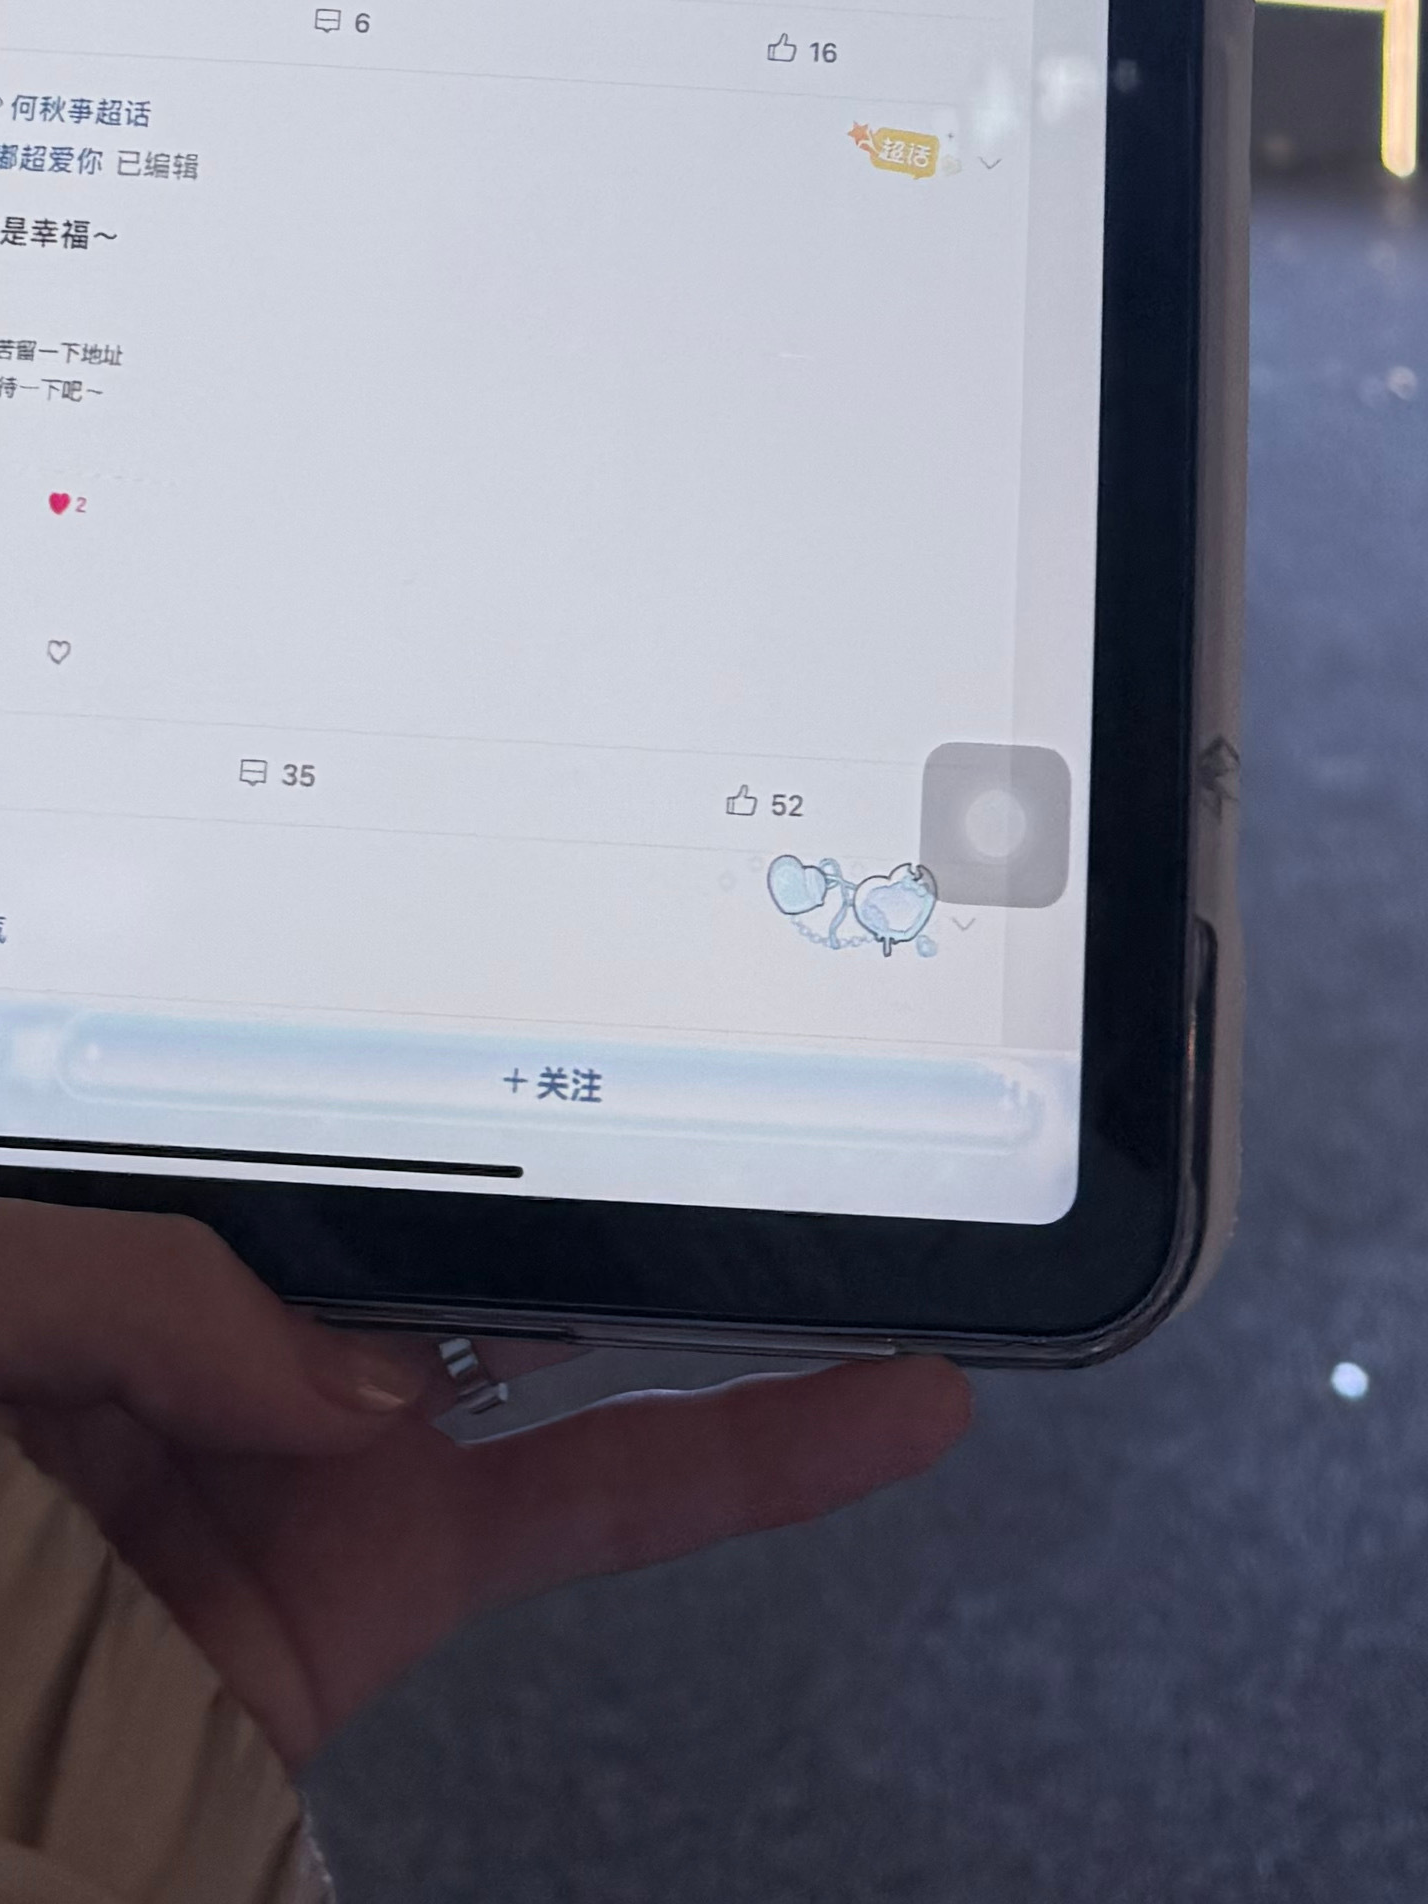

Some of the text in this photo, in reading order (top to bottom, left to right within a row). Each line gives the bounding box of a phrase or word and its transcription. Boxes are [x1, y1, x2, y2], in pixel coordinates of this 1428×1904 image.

[354, 12, 371, 35] 6
[809, 42, 838, 65] 16
[116, 148, 200, 181] 已编辑
[282, 764, 317, 789] 35
[771, 793, 804, 818] 52
